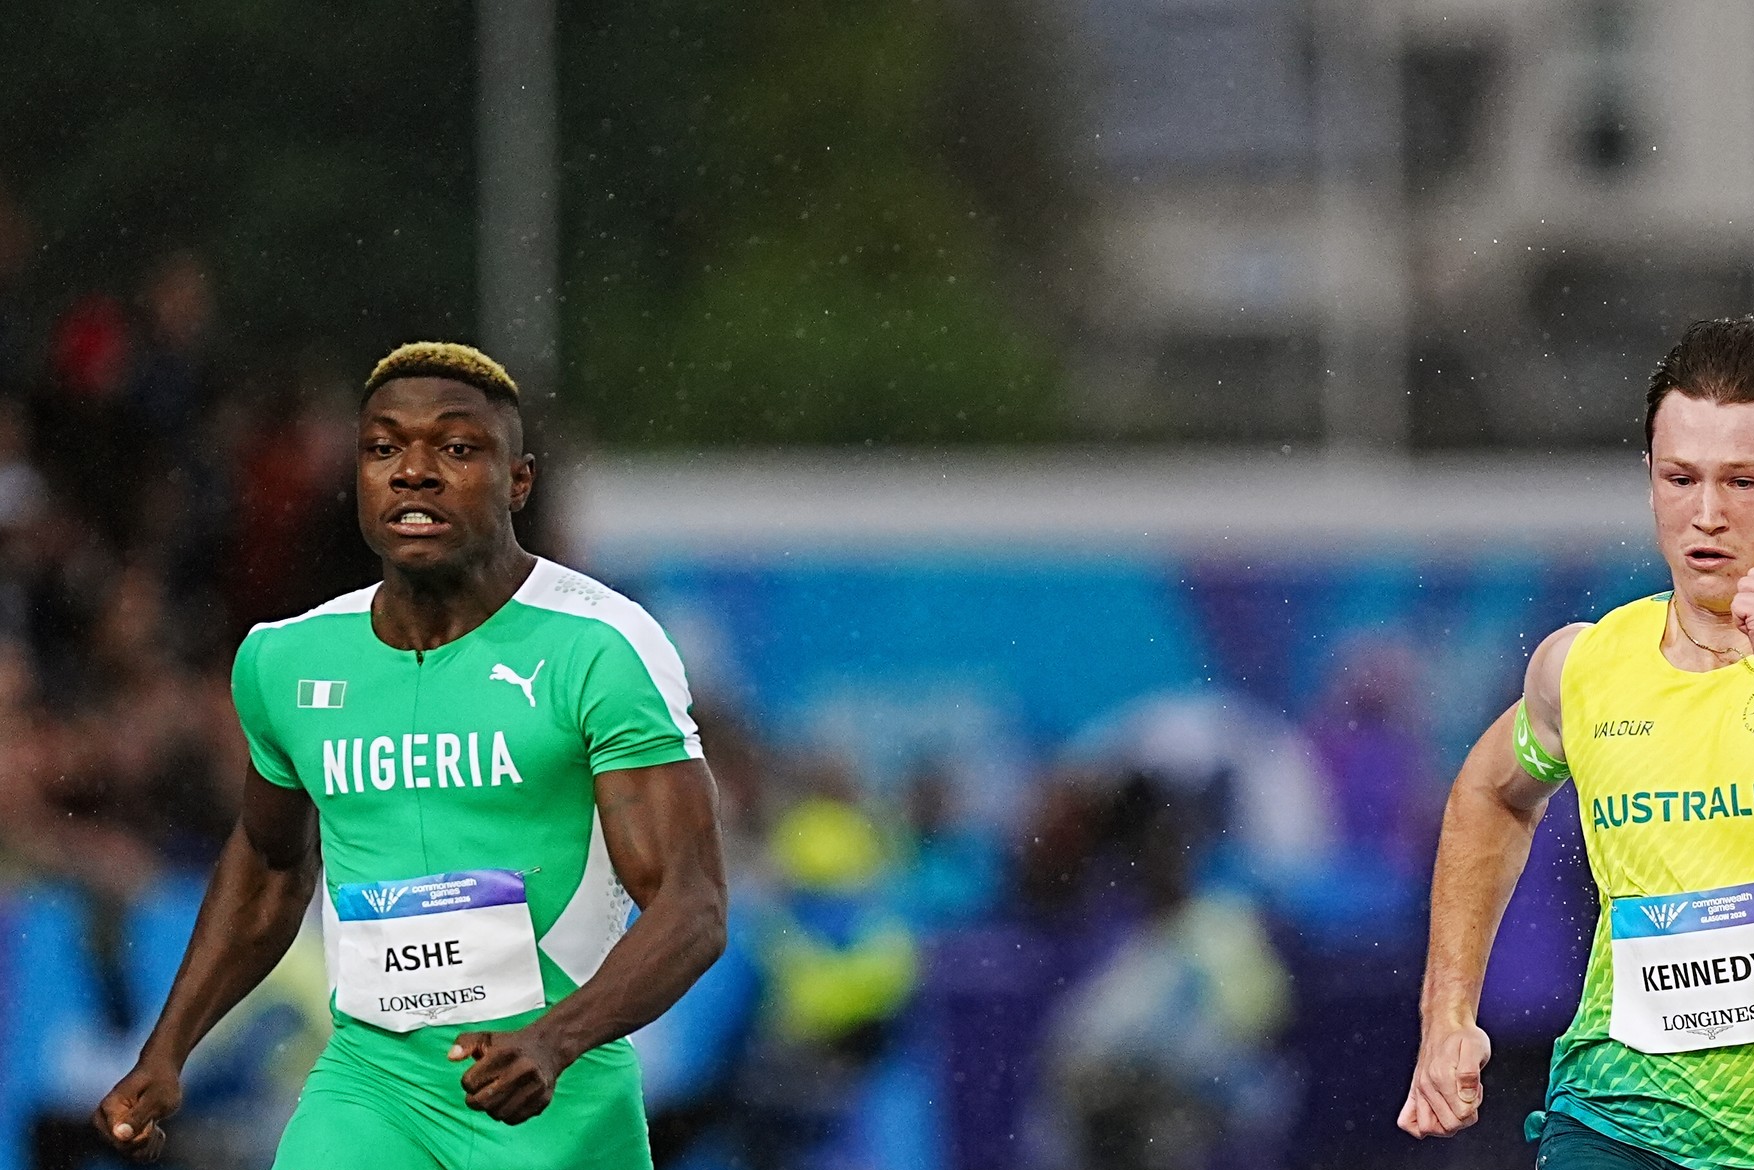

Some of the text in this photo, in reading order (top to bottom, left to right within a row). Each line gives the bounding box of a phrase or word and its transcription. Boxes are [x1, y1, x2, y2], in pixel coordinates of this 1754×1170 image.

[1594, 720, 1654, 739] VALOUR
[323, 731, 524, 796] NIGERIA
[1692, 892, 1753, 909] commonwealth
[1707, 903, 1736, 916] games
[1700, 911, 1747, 924] GLASGOW 2026
[385, 940, 463, 972] ASHE
[379, 985, 486, 1012] LONGINES
